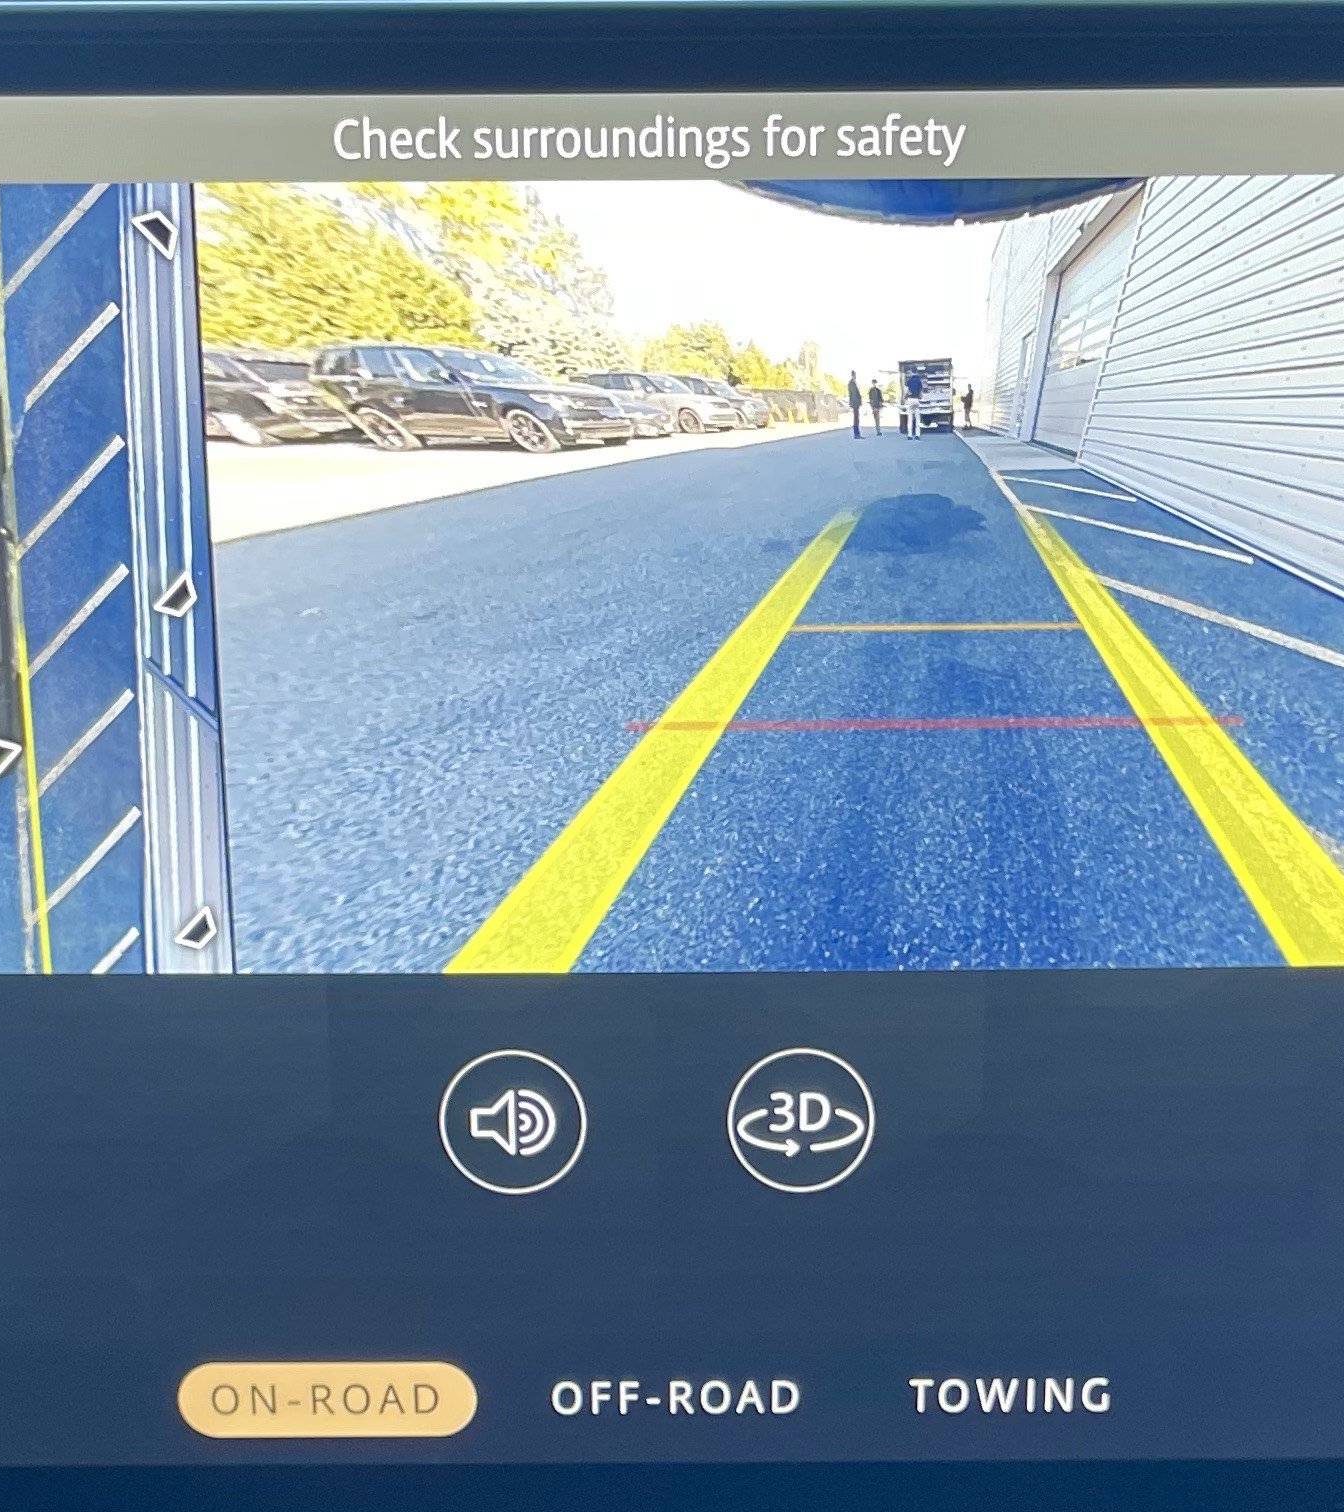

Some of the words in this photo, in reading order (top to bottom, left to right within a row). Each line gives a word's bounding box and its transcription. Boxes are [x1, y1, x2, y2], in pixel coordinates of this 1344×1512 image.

[333, 116, 462, 162] Check
[473, 115, 753, 168] surroundings
[762, 114, 825, 158] for
[835, 114, 967, 166] safety
[769, 1093, 834, 1132] 3D
[210, 1383, 441, 1417] ON-ROAD
[551, 1380, 801, 1416] OFF-ROAD
[909, 1377, 1112, 1414] TOWING
